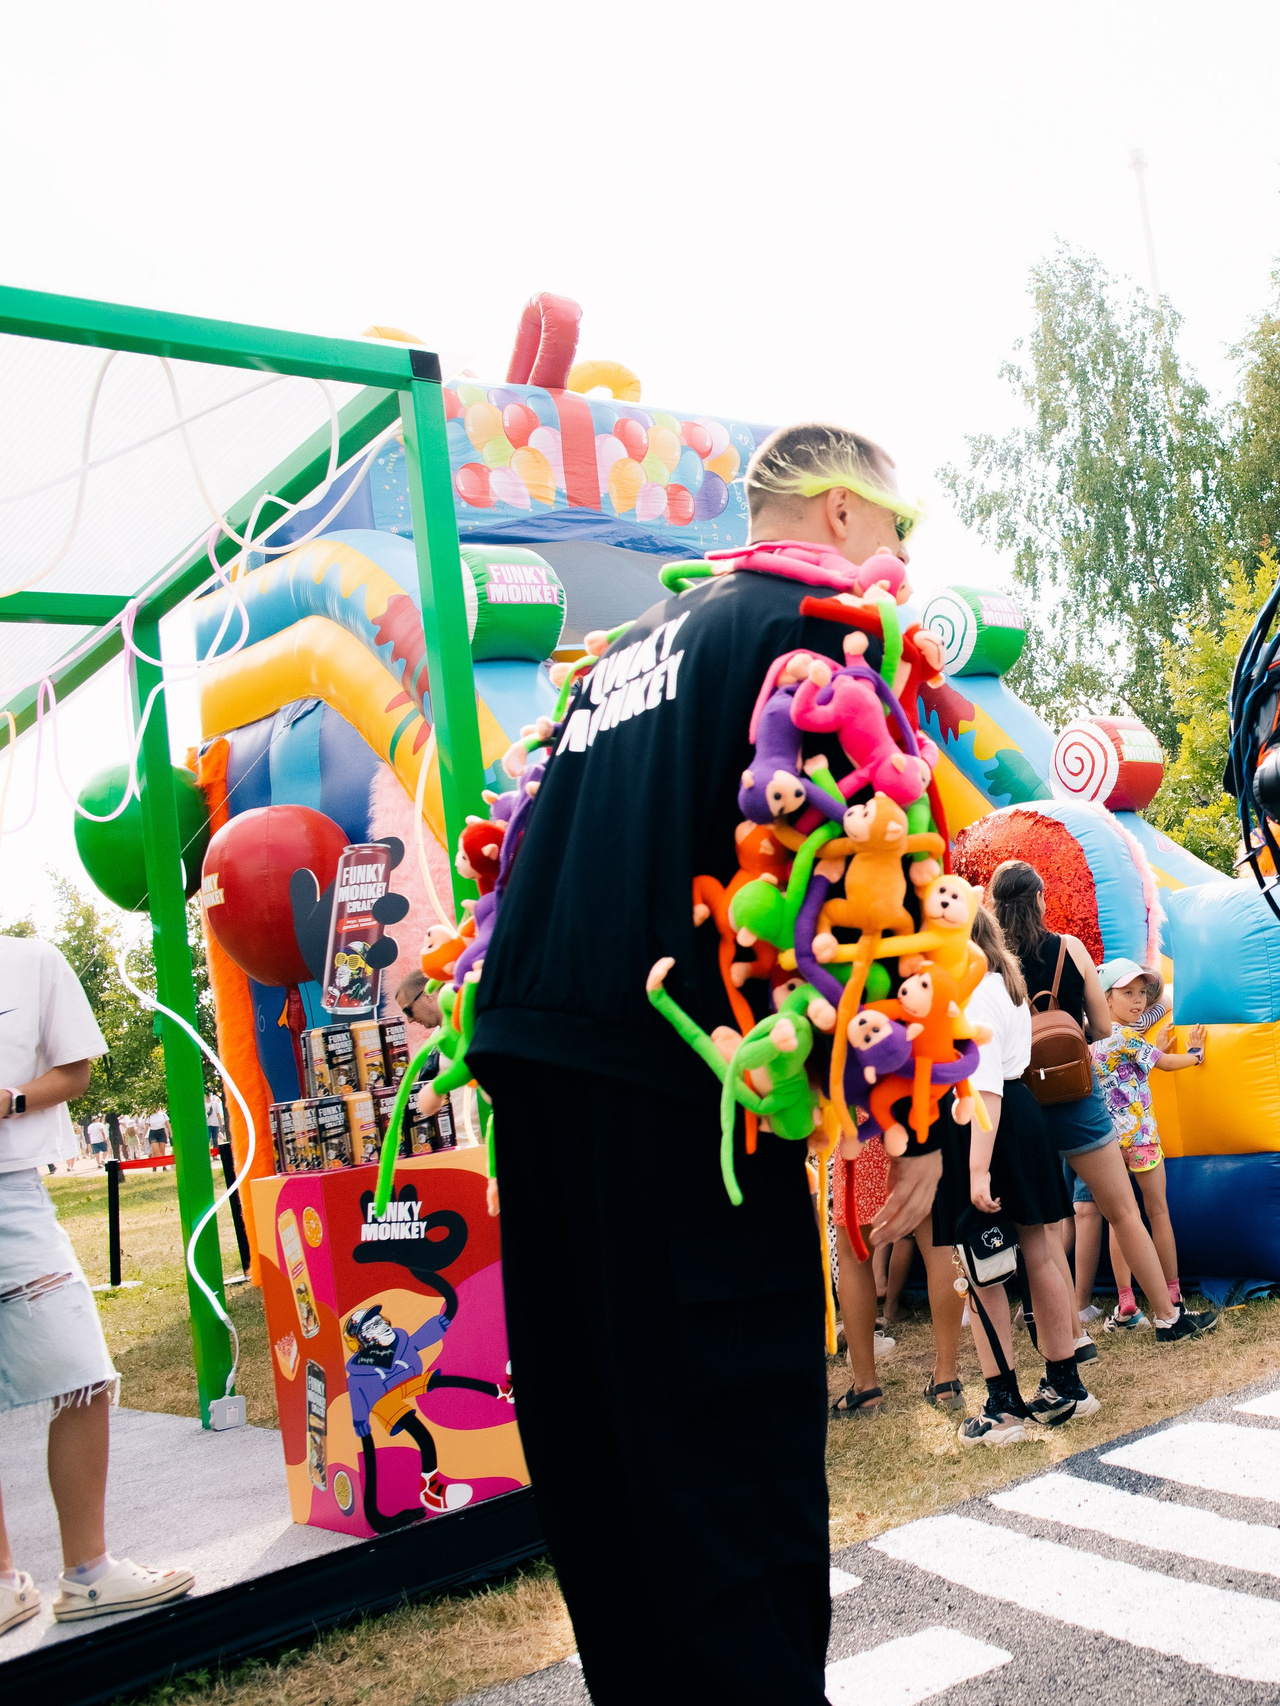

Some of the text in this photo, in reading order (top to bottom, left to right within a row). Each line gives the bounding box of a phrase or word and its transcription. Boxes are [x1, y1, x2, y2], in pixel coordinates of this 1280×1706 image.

[489, 565, 548, 584] FUNKY
[489, 584, 558, 603] MONKEY
[1122, 745, 1163, 764] MONKE
[342, 863, 386, 886] FUNKY
[338, 881, 387, 903] MONKEY
[318, 1112, 345, 1125] MONKE
[361, 1221, 427, 1241] MONKEY
